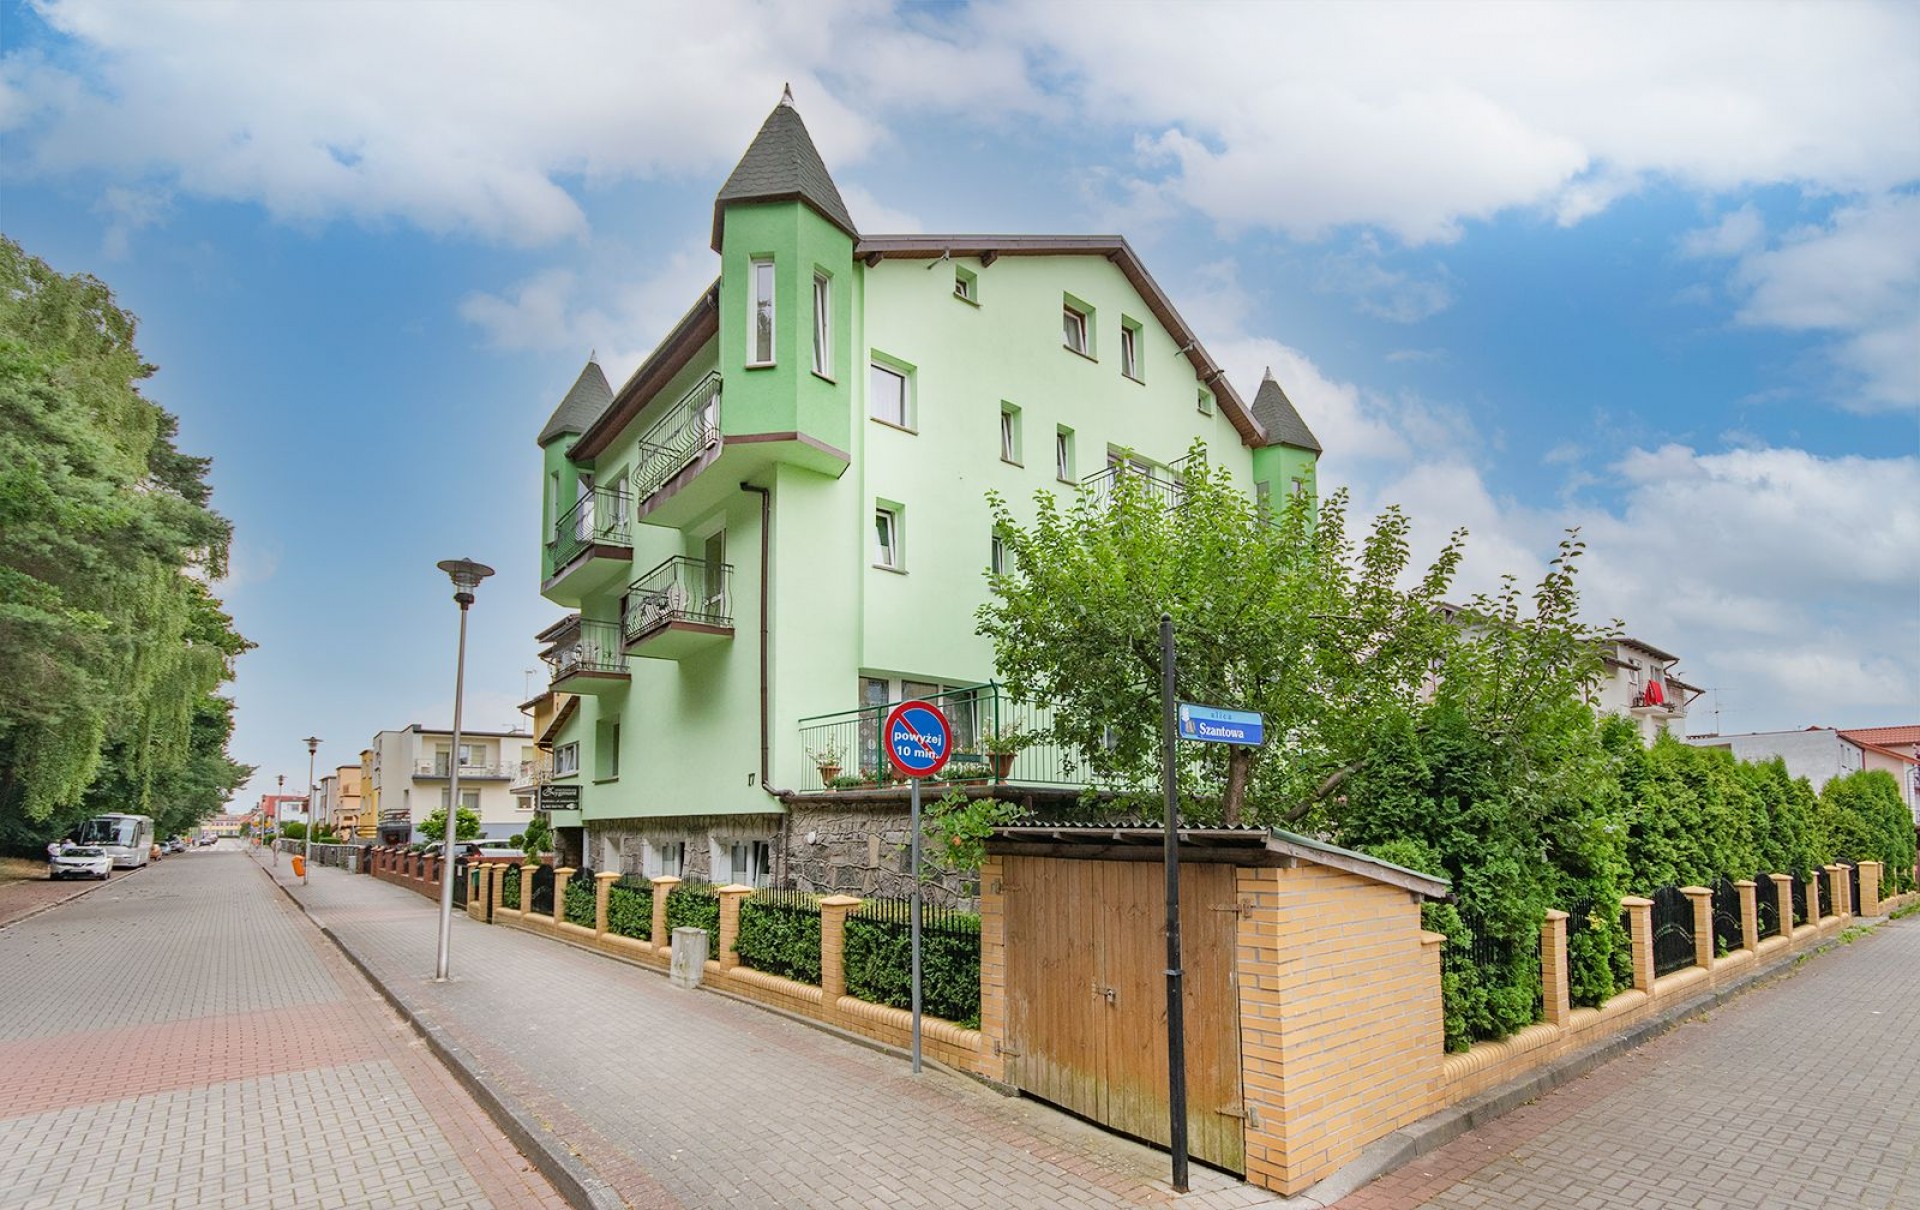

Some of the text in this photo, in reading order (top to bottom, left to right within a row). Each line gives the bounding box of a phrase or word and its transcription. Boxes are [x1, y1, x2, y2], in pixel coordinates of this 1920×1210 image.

[1211, 711, 1232, 720] ulica
[1199, 722, 1244, 738] Szantowa
[894, 732, 942, 746] powyżej
[897, 745, 911, 756] 10
